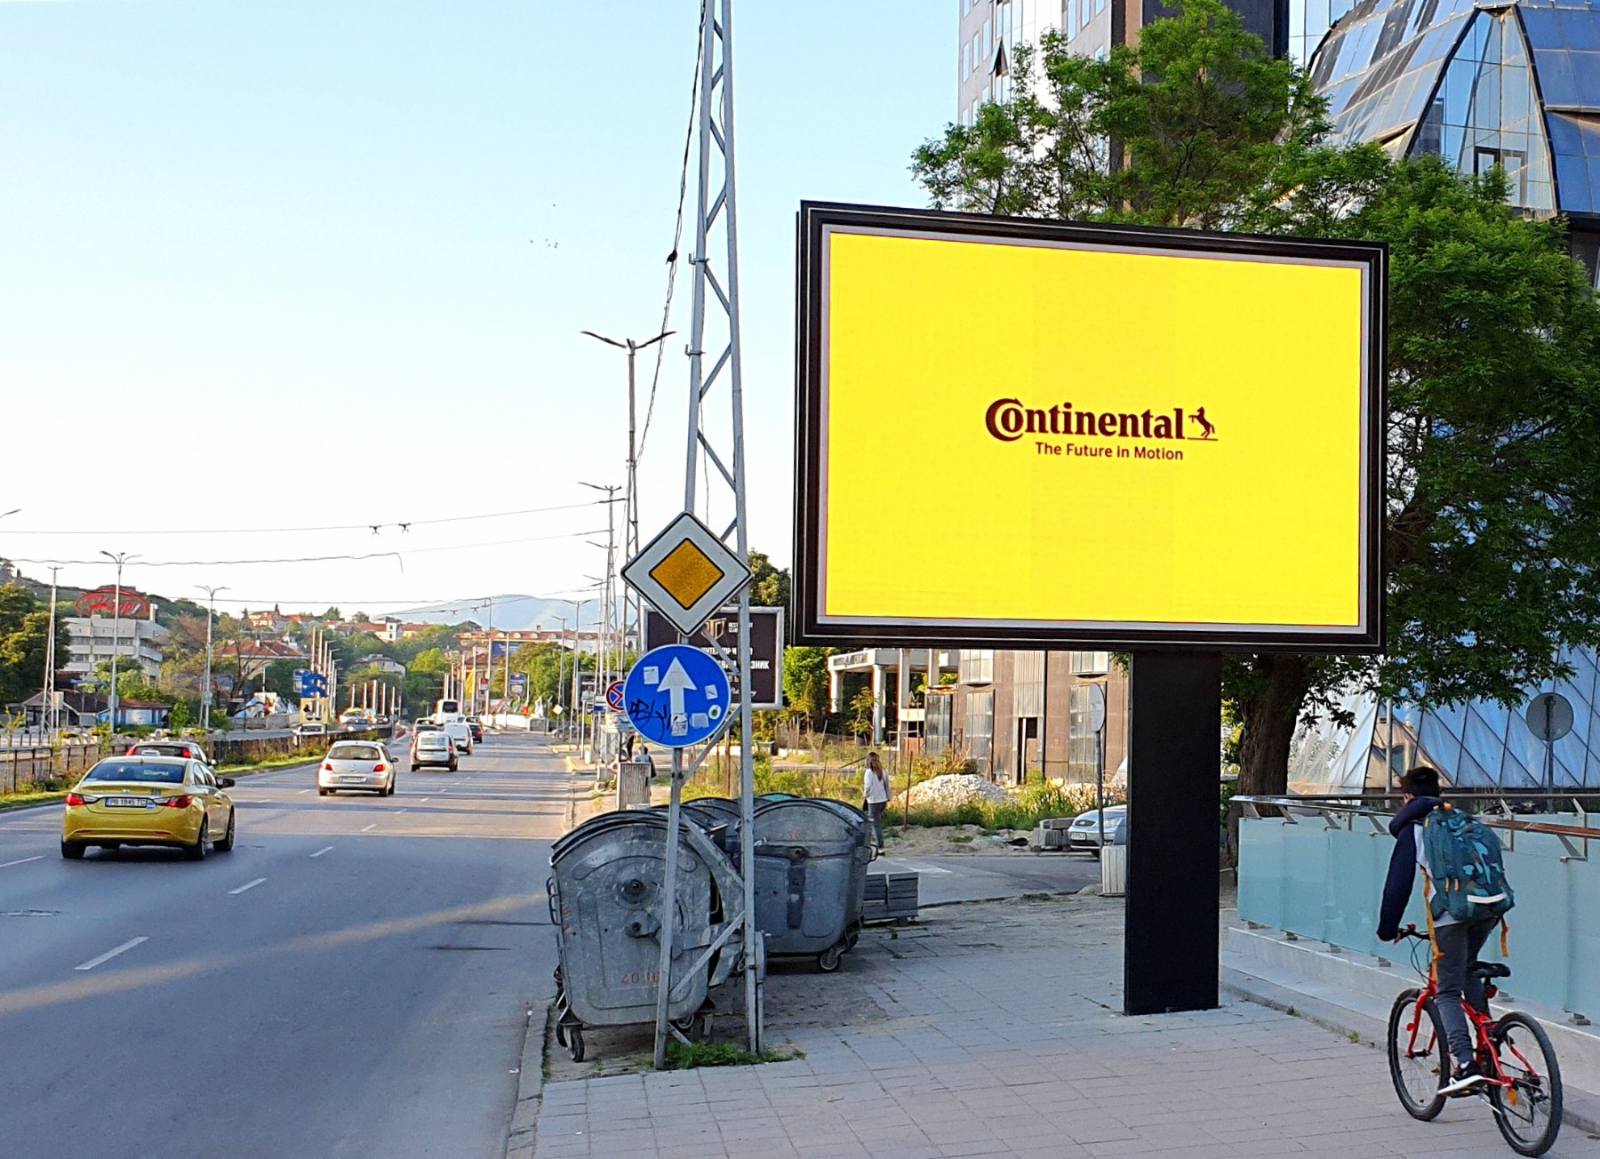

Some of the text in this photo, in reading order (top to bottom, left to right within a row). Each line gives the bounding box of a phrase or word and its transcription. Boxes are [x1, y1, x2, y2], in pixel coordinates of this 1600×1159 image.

[984, 397, 1186, 442] Continental
[1035, 441, 1062, 456] The
[1066, 442, 1113, 458] Future
[1134, 445, 1184, 461] Motion
